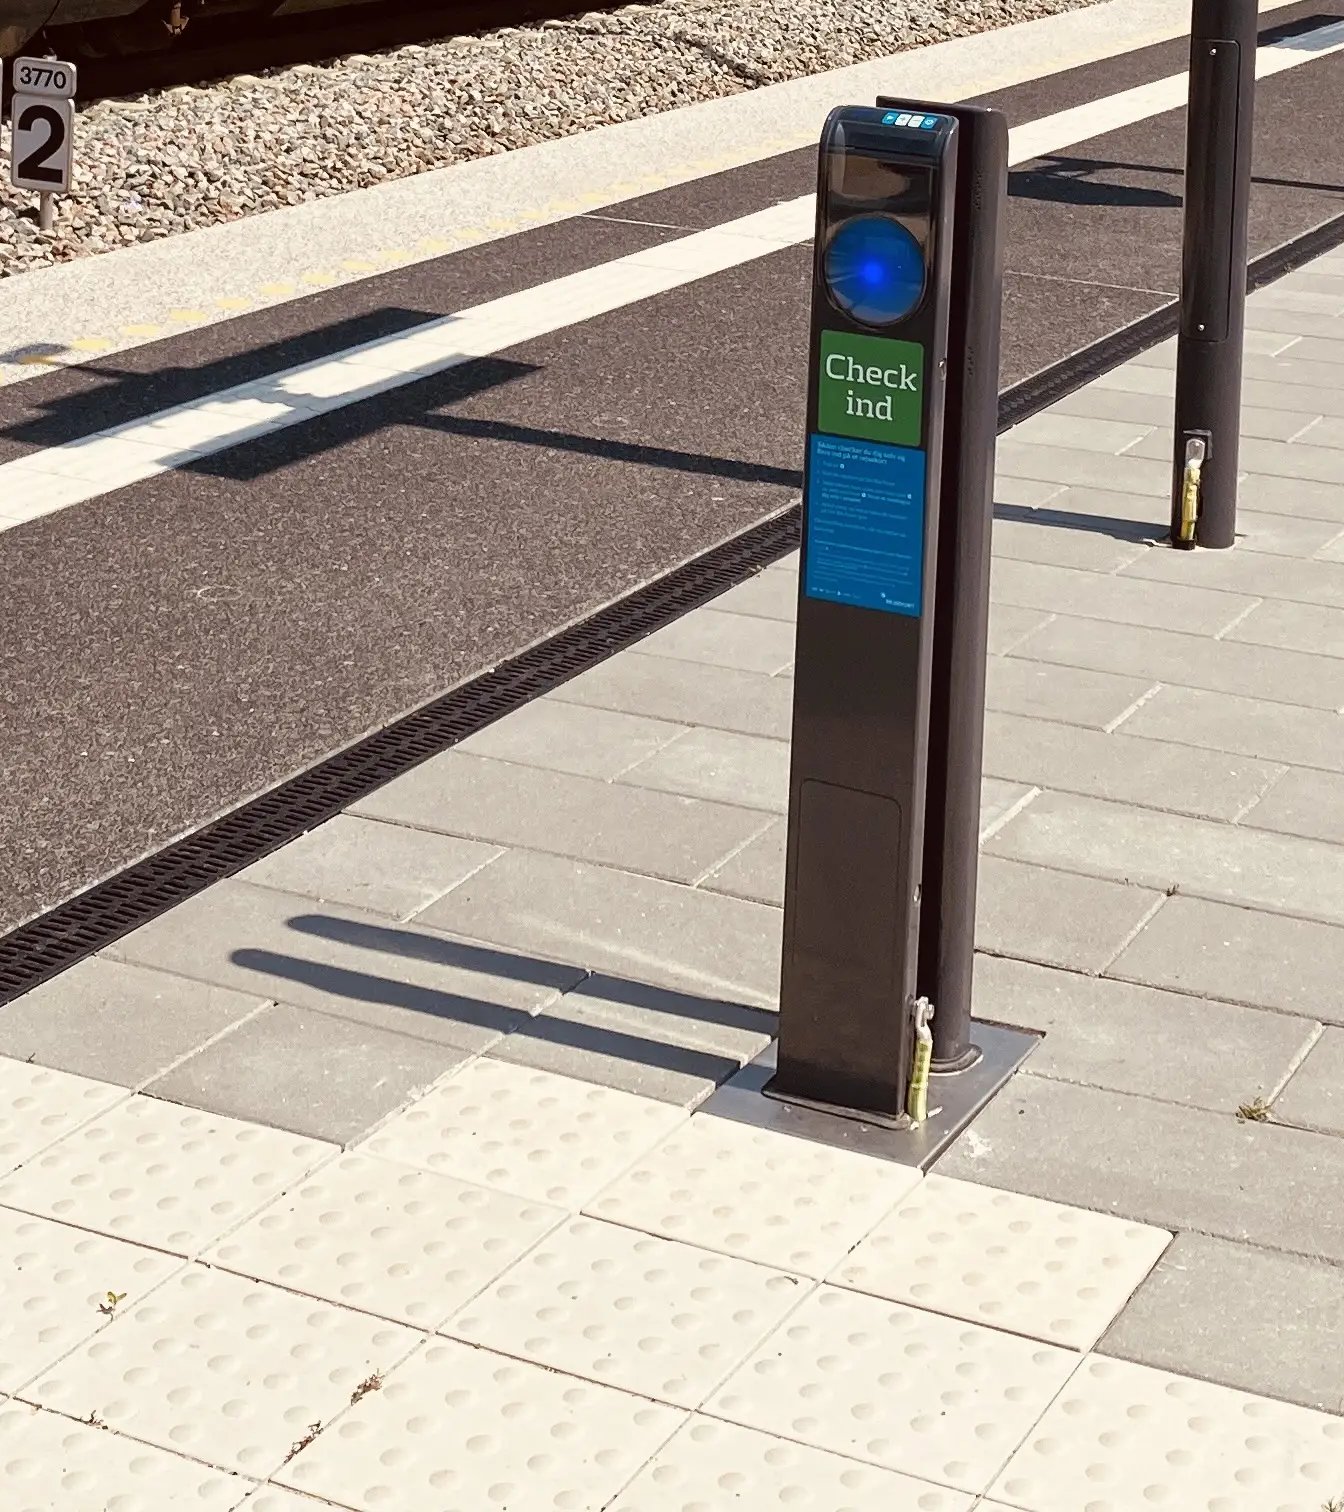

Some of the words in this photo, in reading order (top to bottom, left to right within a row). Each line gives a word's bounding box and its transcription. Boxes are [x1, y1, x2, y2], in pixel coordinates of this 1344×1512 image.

[19, 66, 67, 90] 3770
[17, 104, 65, 184] 2
[826, 353, 917, 392] Check
[846, 389, 893, 421] ind
